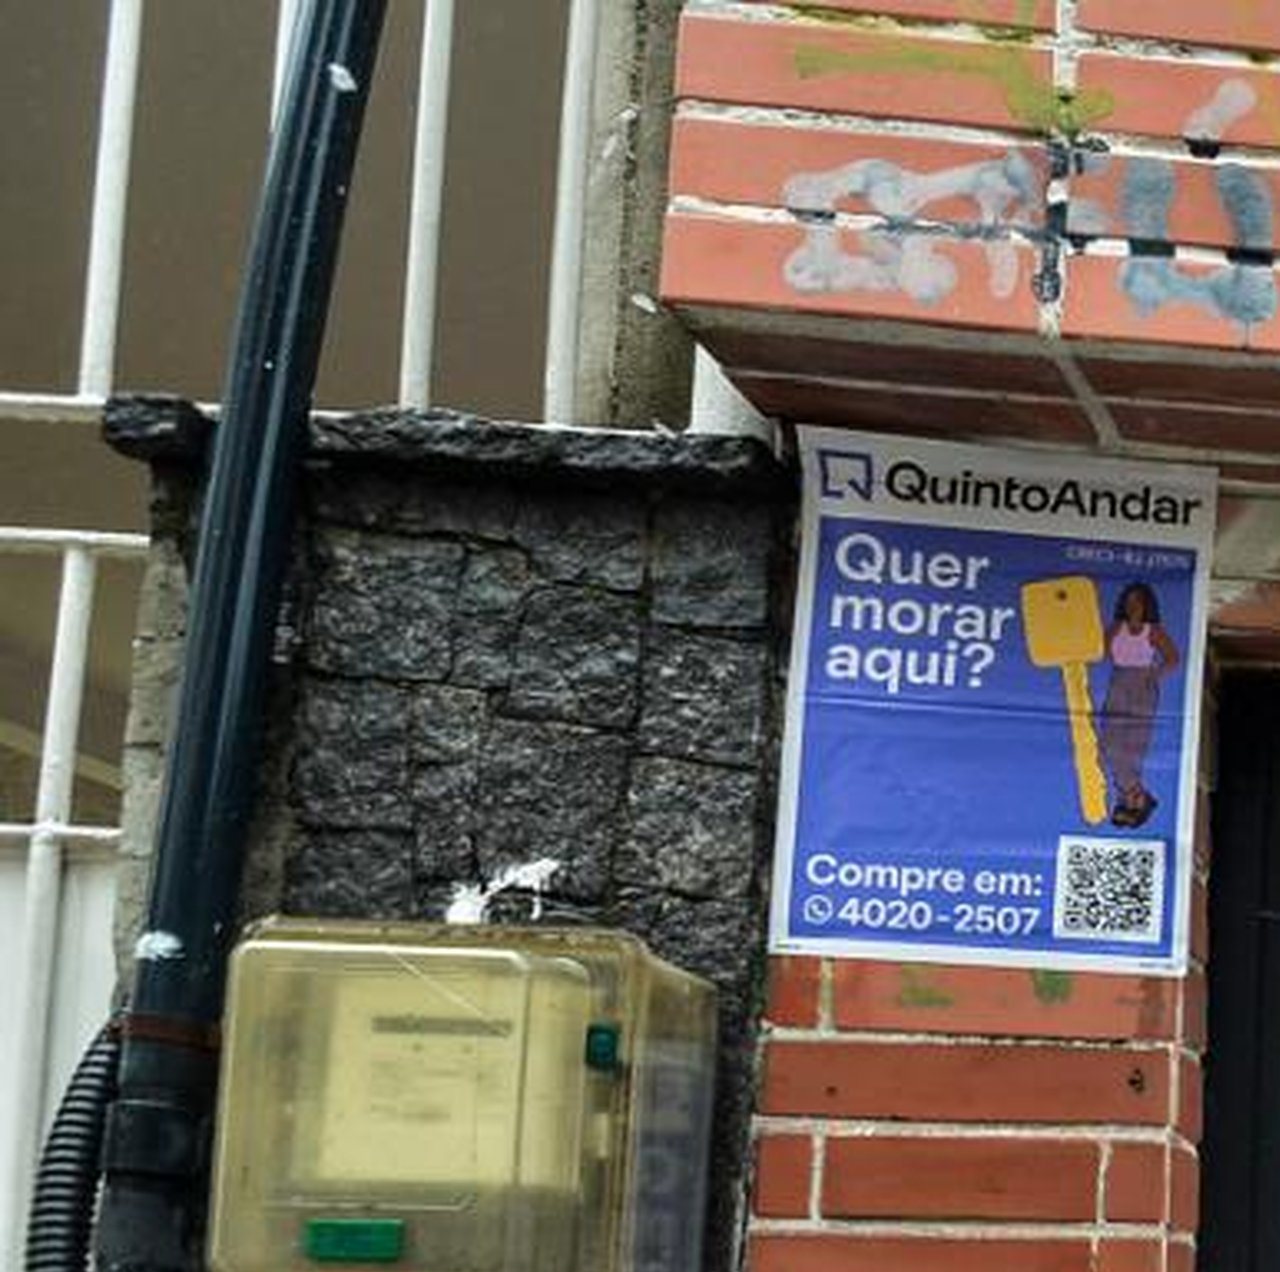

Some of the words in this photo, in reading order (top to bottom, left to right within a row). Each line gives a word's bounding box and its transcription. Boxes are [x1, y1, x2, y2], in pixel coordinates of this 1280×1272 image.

[885, 461, 1201, 525] QuintoAndar
[835, 532, 990, 590] Quer
[829, 594, 1015, 641] morar
[825, 640, 995, 694] aqui?
[806, 854, 965, 895] Compre
[973, 870, 1042, 896] em:
[837, 898, 1041, 934] 4020-2507
